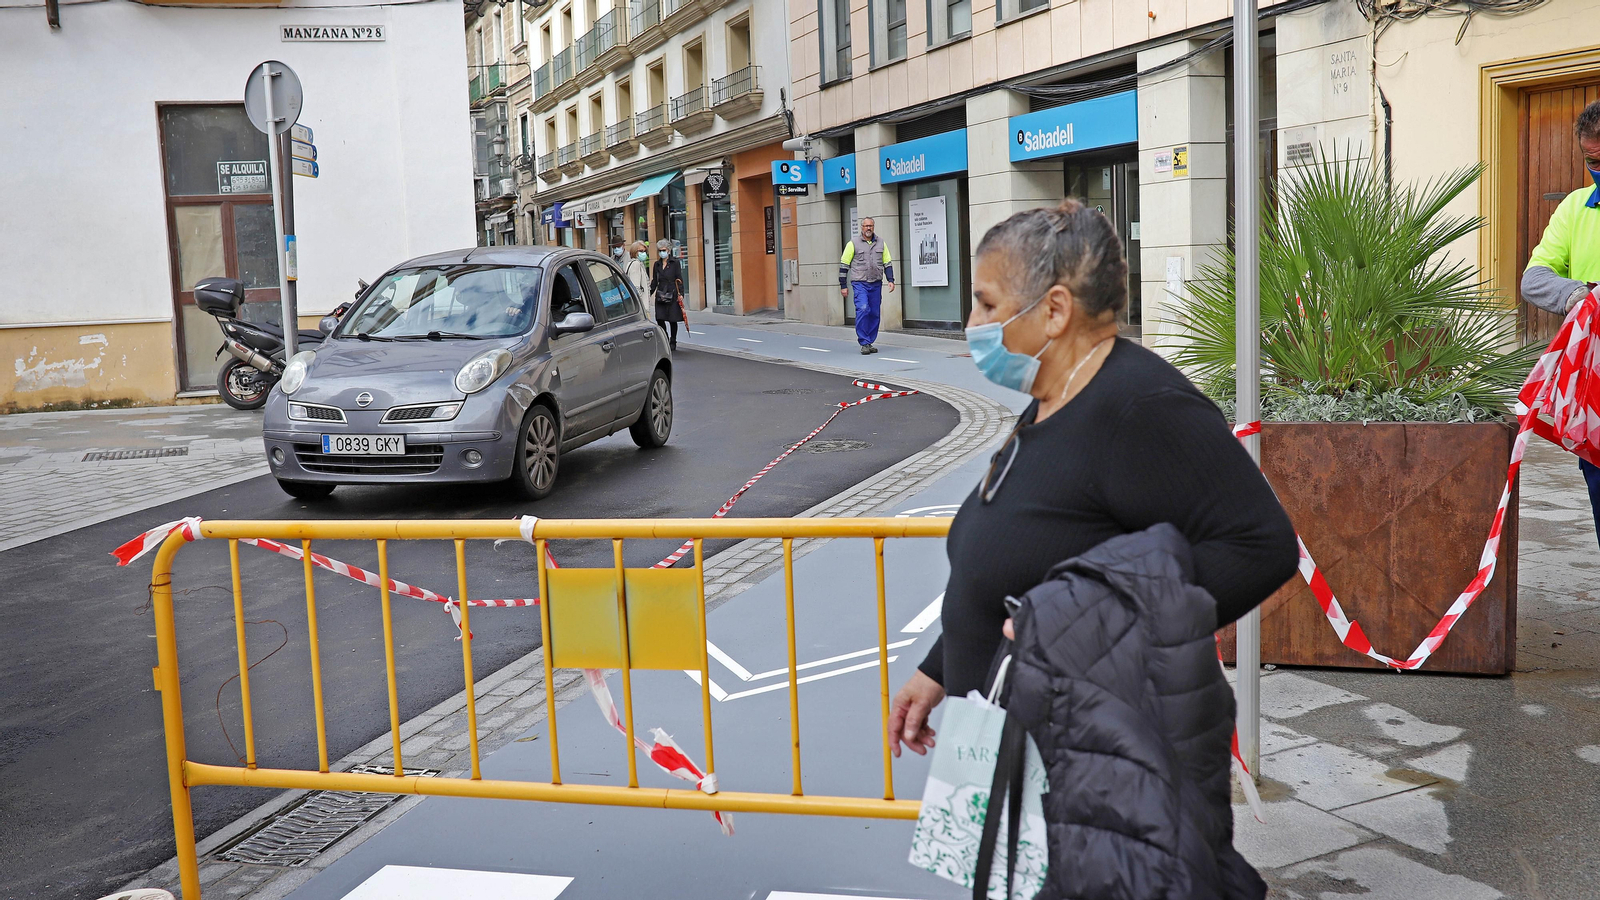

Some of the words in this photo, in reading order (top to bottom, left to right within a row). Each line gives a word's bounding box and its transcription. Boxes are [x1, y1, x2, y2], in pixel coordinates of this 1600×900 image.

[283, 28, 348, 38] MANZANA
[1331, 50, 1356, 65] SANTA
[1331, 66, 1356, 80] MARIA
[1024, 123, 1074, 152] Sabadell
[220, 164, 231, 175] SE
[231, 164, 264, 175] ALQUILA
[890, 154, 925, 176] Sabadell
[790, 165, 802, 182] S
[845, 168, 851, 184] S
[336, 437, 370, 451] 0839
[376, 437, 400, 452] GKY
